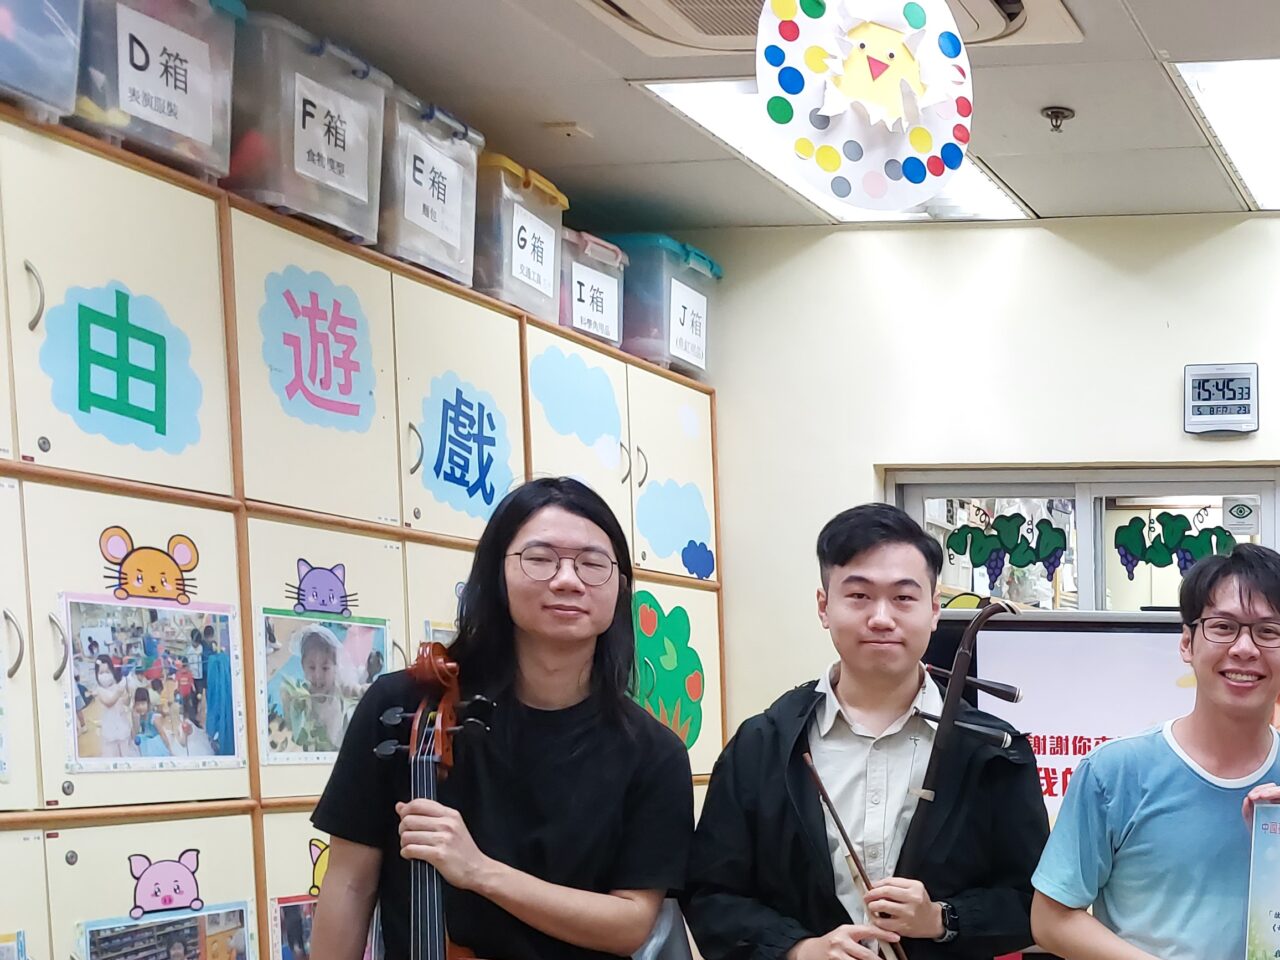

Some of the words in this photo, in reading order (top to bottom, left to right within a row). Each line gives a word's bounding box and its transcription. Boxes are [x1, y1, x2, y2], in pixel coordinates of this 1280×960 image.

[78, 291, 167, 437] 由
[283, 289, 361, 416] 遊
[433, 388, 496, 505] 戲
